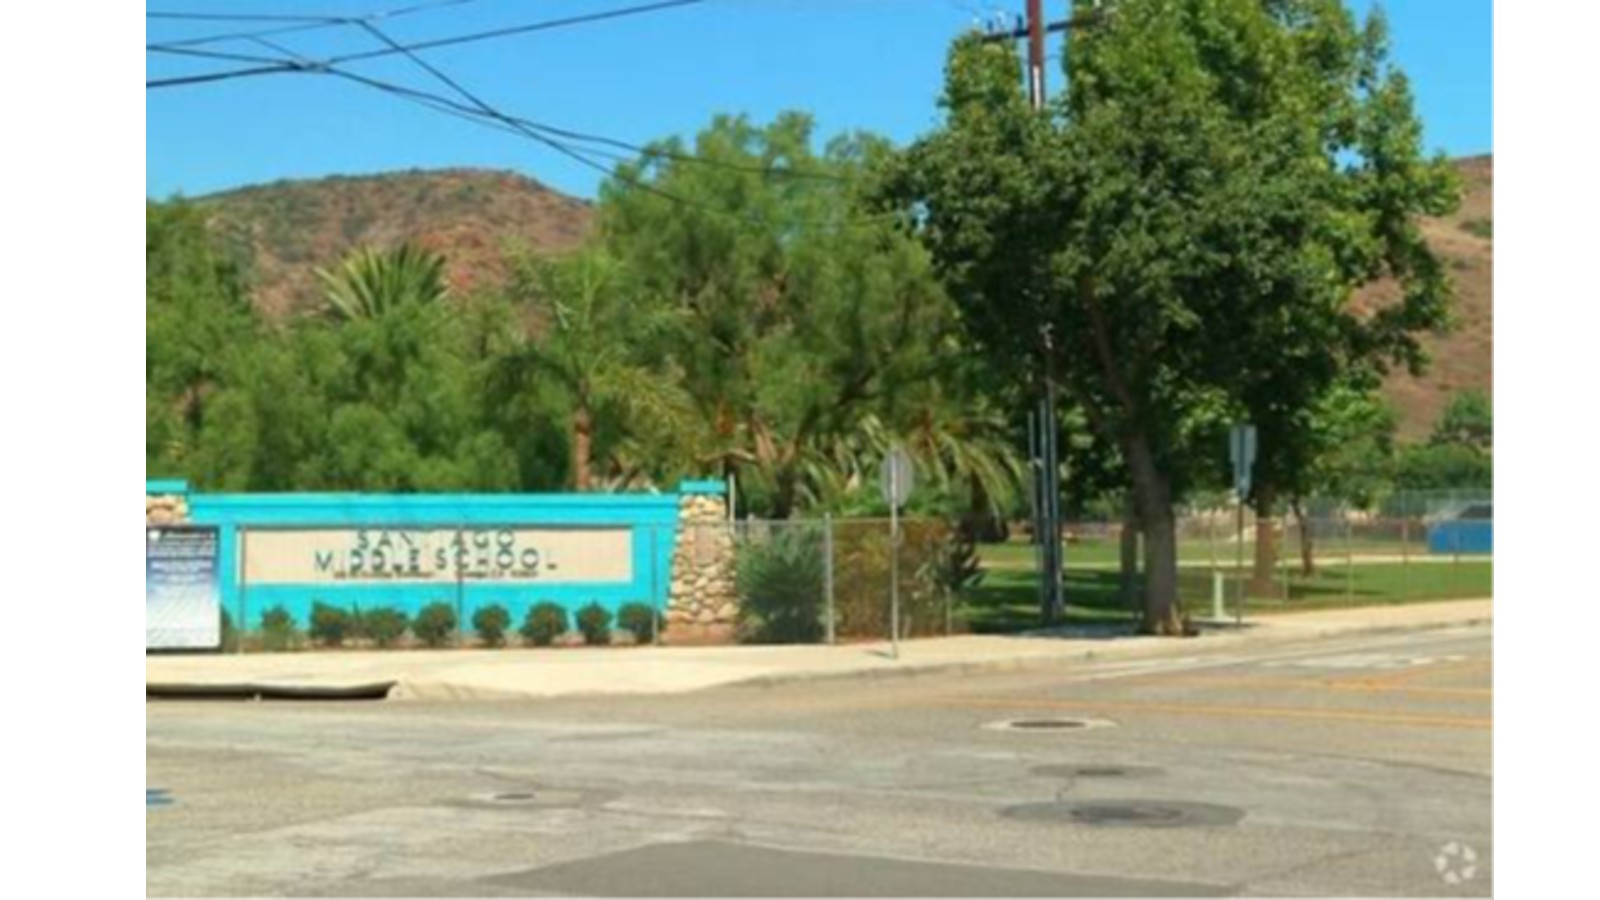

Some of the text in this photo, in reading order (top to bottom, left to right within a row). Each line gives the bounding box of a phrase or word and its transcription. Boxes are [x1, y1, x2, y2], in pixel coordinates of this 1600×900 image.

[356, 528, 515, 550] SANAGO
[314, 547, 559, 571] MIDDLE SCHOOL
